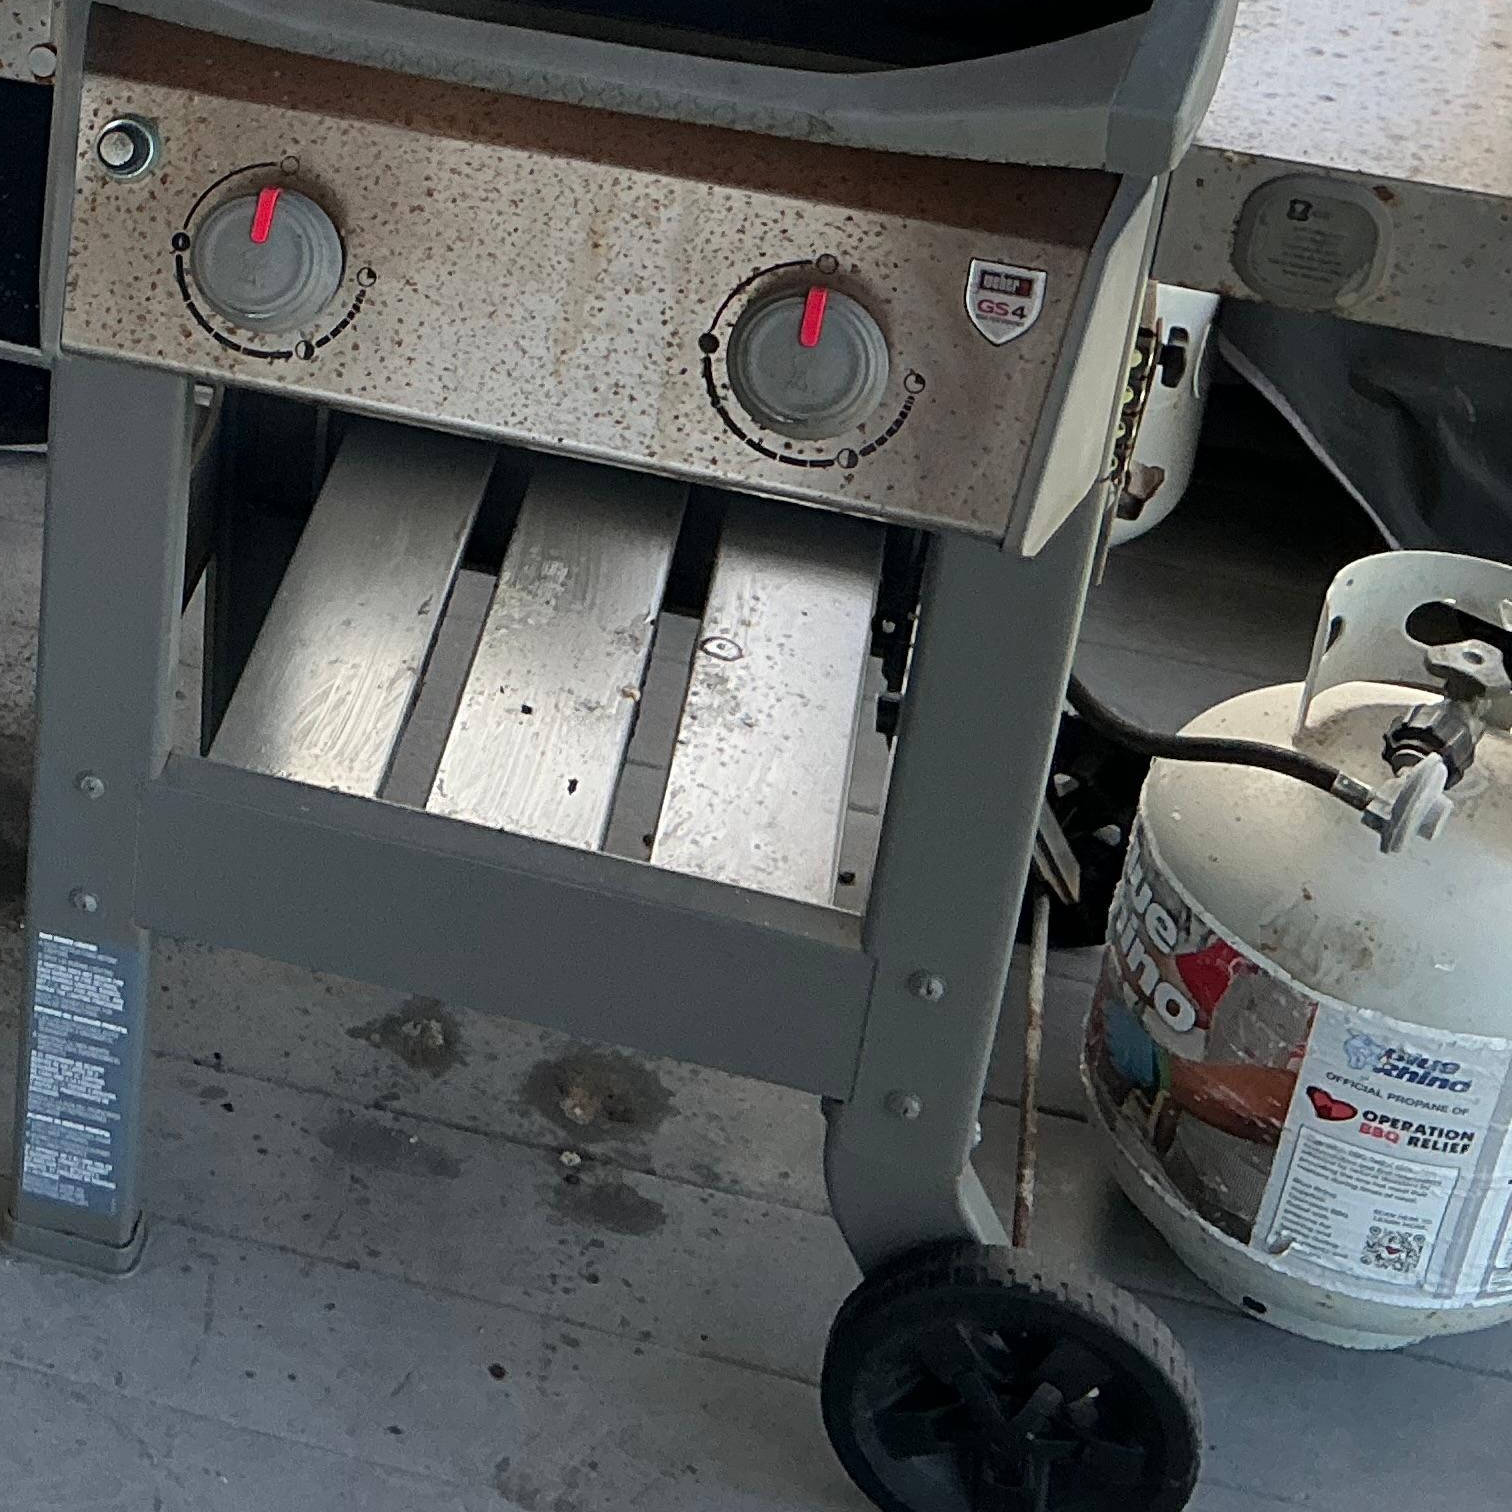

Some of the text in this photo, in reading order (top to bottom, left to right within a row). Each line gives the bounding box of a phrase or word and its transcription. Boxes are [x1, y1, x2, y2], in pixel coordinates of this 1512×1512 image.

[1325, 1071, 1471, 1117] OFFICIAL PROPANE OF
[1373, 1062, 1473, 1093] Rhino
[1359, 1121, 1471, 1156] BBQ RELIEF
[1362, 1109, 1476, 1143] OPERATION
